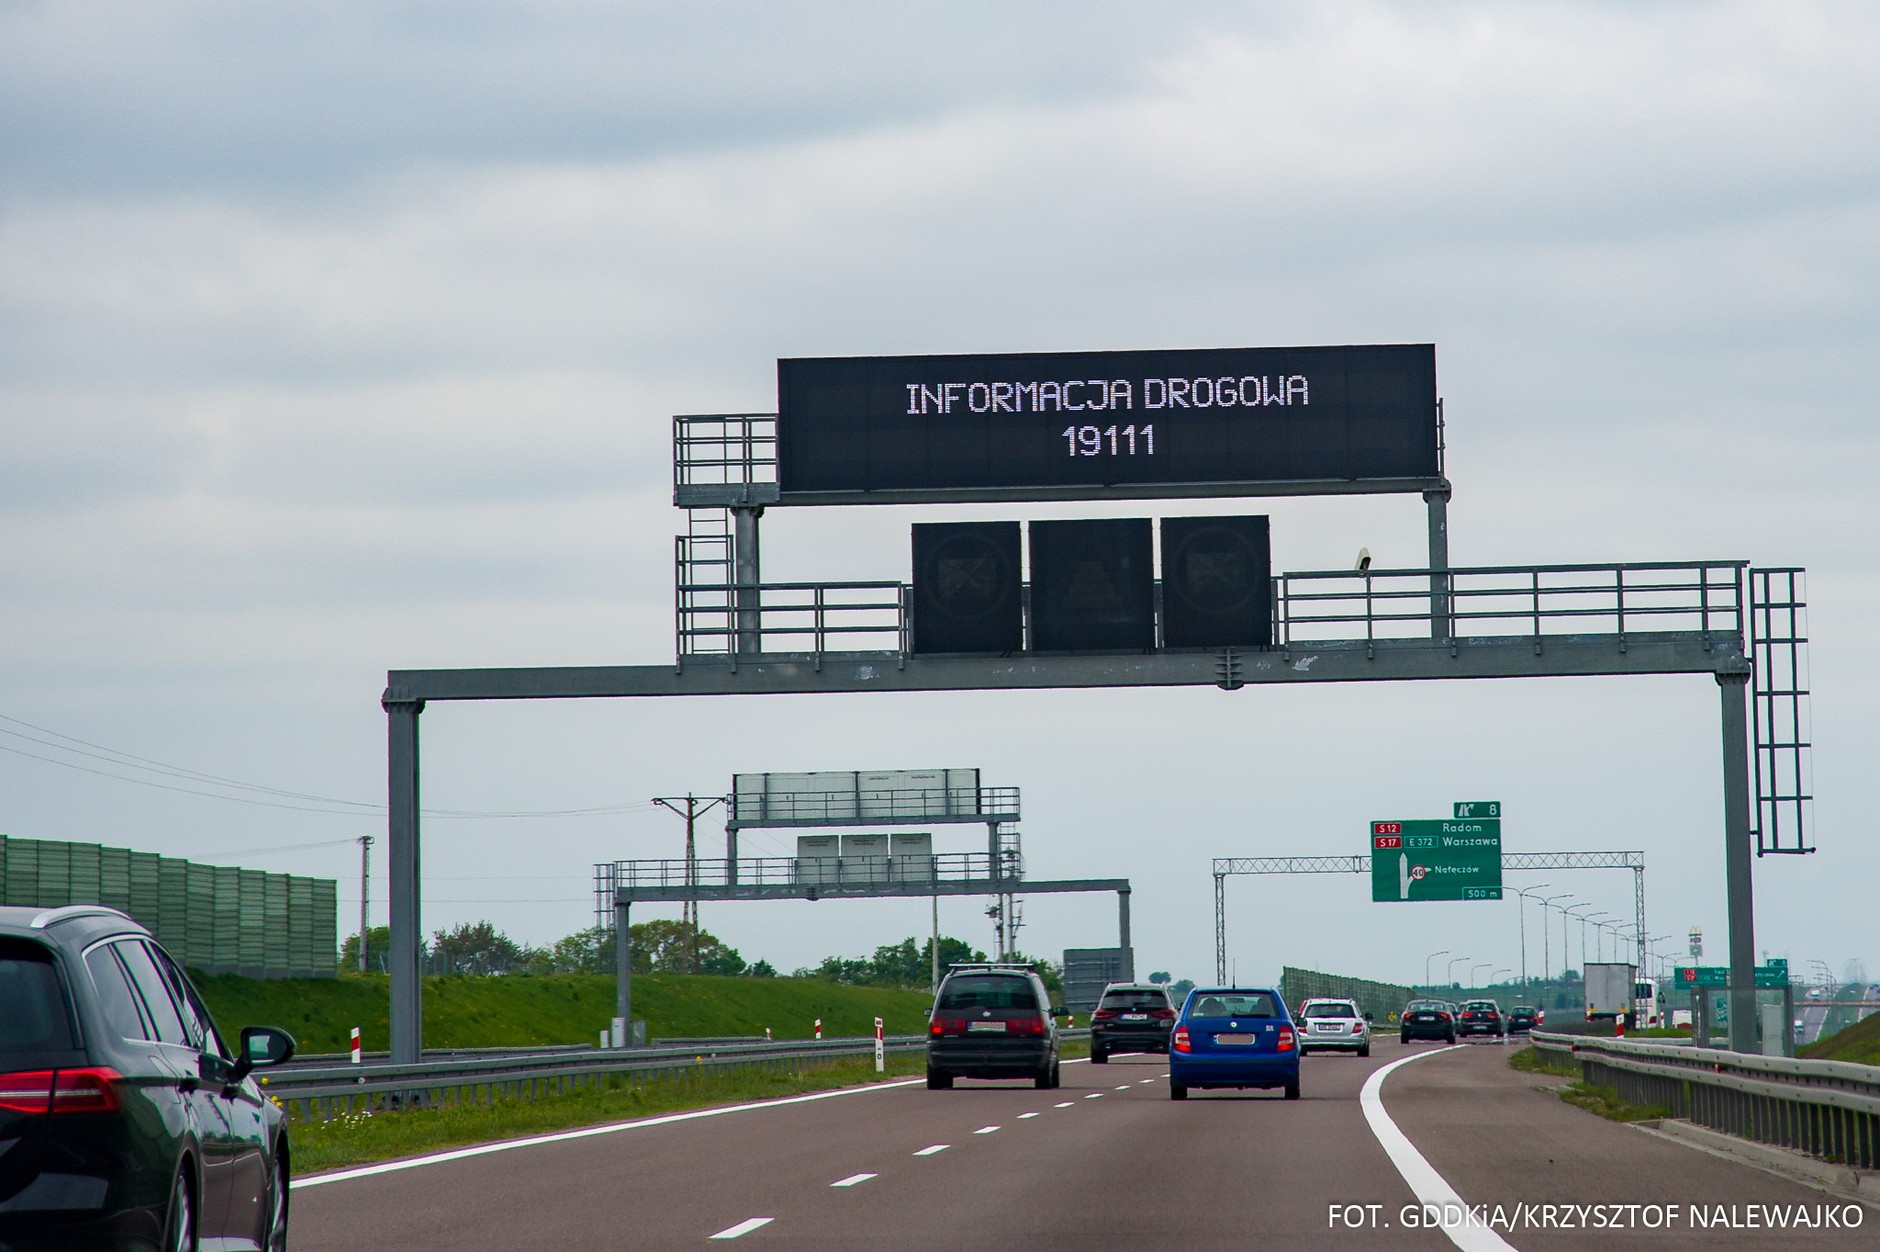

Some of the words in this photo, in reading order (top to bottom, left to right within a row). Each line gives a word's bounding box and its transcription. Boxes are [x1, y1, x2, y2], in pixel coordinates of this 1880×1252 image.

[906, 379, 1133, 414] INFORMACJA
[1144, 375, 1310, 410] DROGOWA
[1062, 424, 1155, 457] 19111
[1489, 804, 1497, 815] 8
[1380, 824, 1386, 833] S
[1387, 824, 1397, 833] 12
[1443, 823, 1482, 832] Radom
[1380, 838, 1386, 847] S
[1388, 838, 1397, 847] 17
[1410, 838, 1415, 846] E
[1417, 838, 1433, 846] 372
[1443, 837, 1498, 846] Warszawa
[1413, 868, 1423, 877] 40
[1434, 866, 1479, 875] Nałęczów
[1468, 890, 1486, 898] 500
